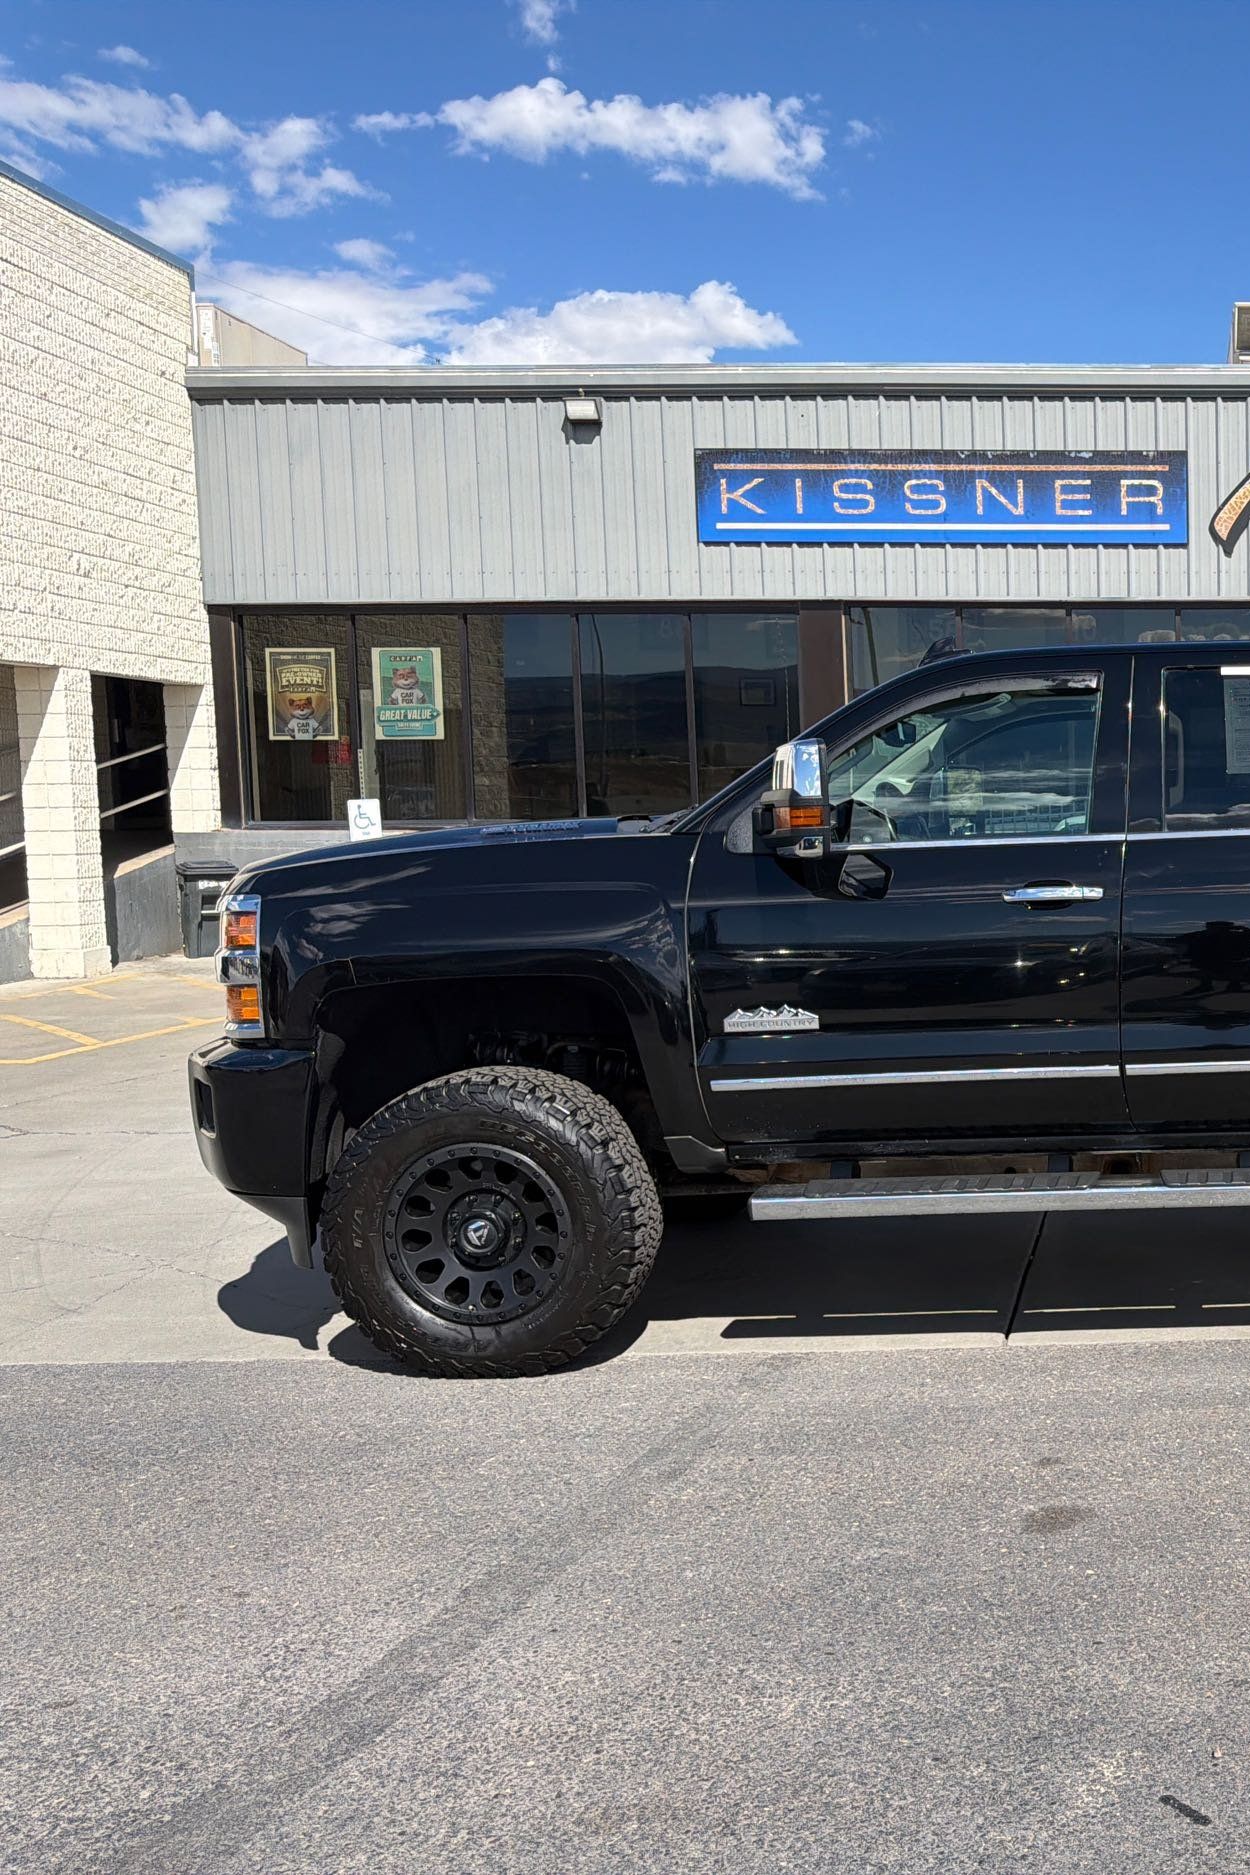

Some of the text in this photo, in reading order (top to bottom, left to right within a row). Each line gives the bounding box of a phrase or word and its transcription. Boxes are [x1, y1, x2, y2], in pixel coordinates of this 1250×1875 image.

[720, 477, 1164, 516] KISSNER
[281, 677, 322, 686] EVENT!
[379, 708, 433, 721] GREAT VALUE
[728, 1019, 814, 1029] HIGH COUNTRY
